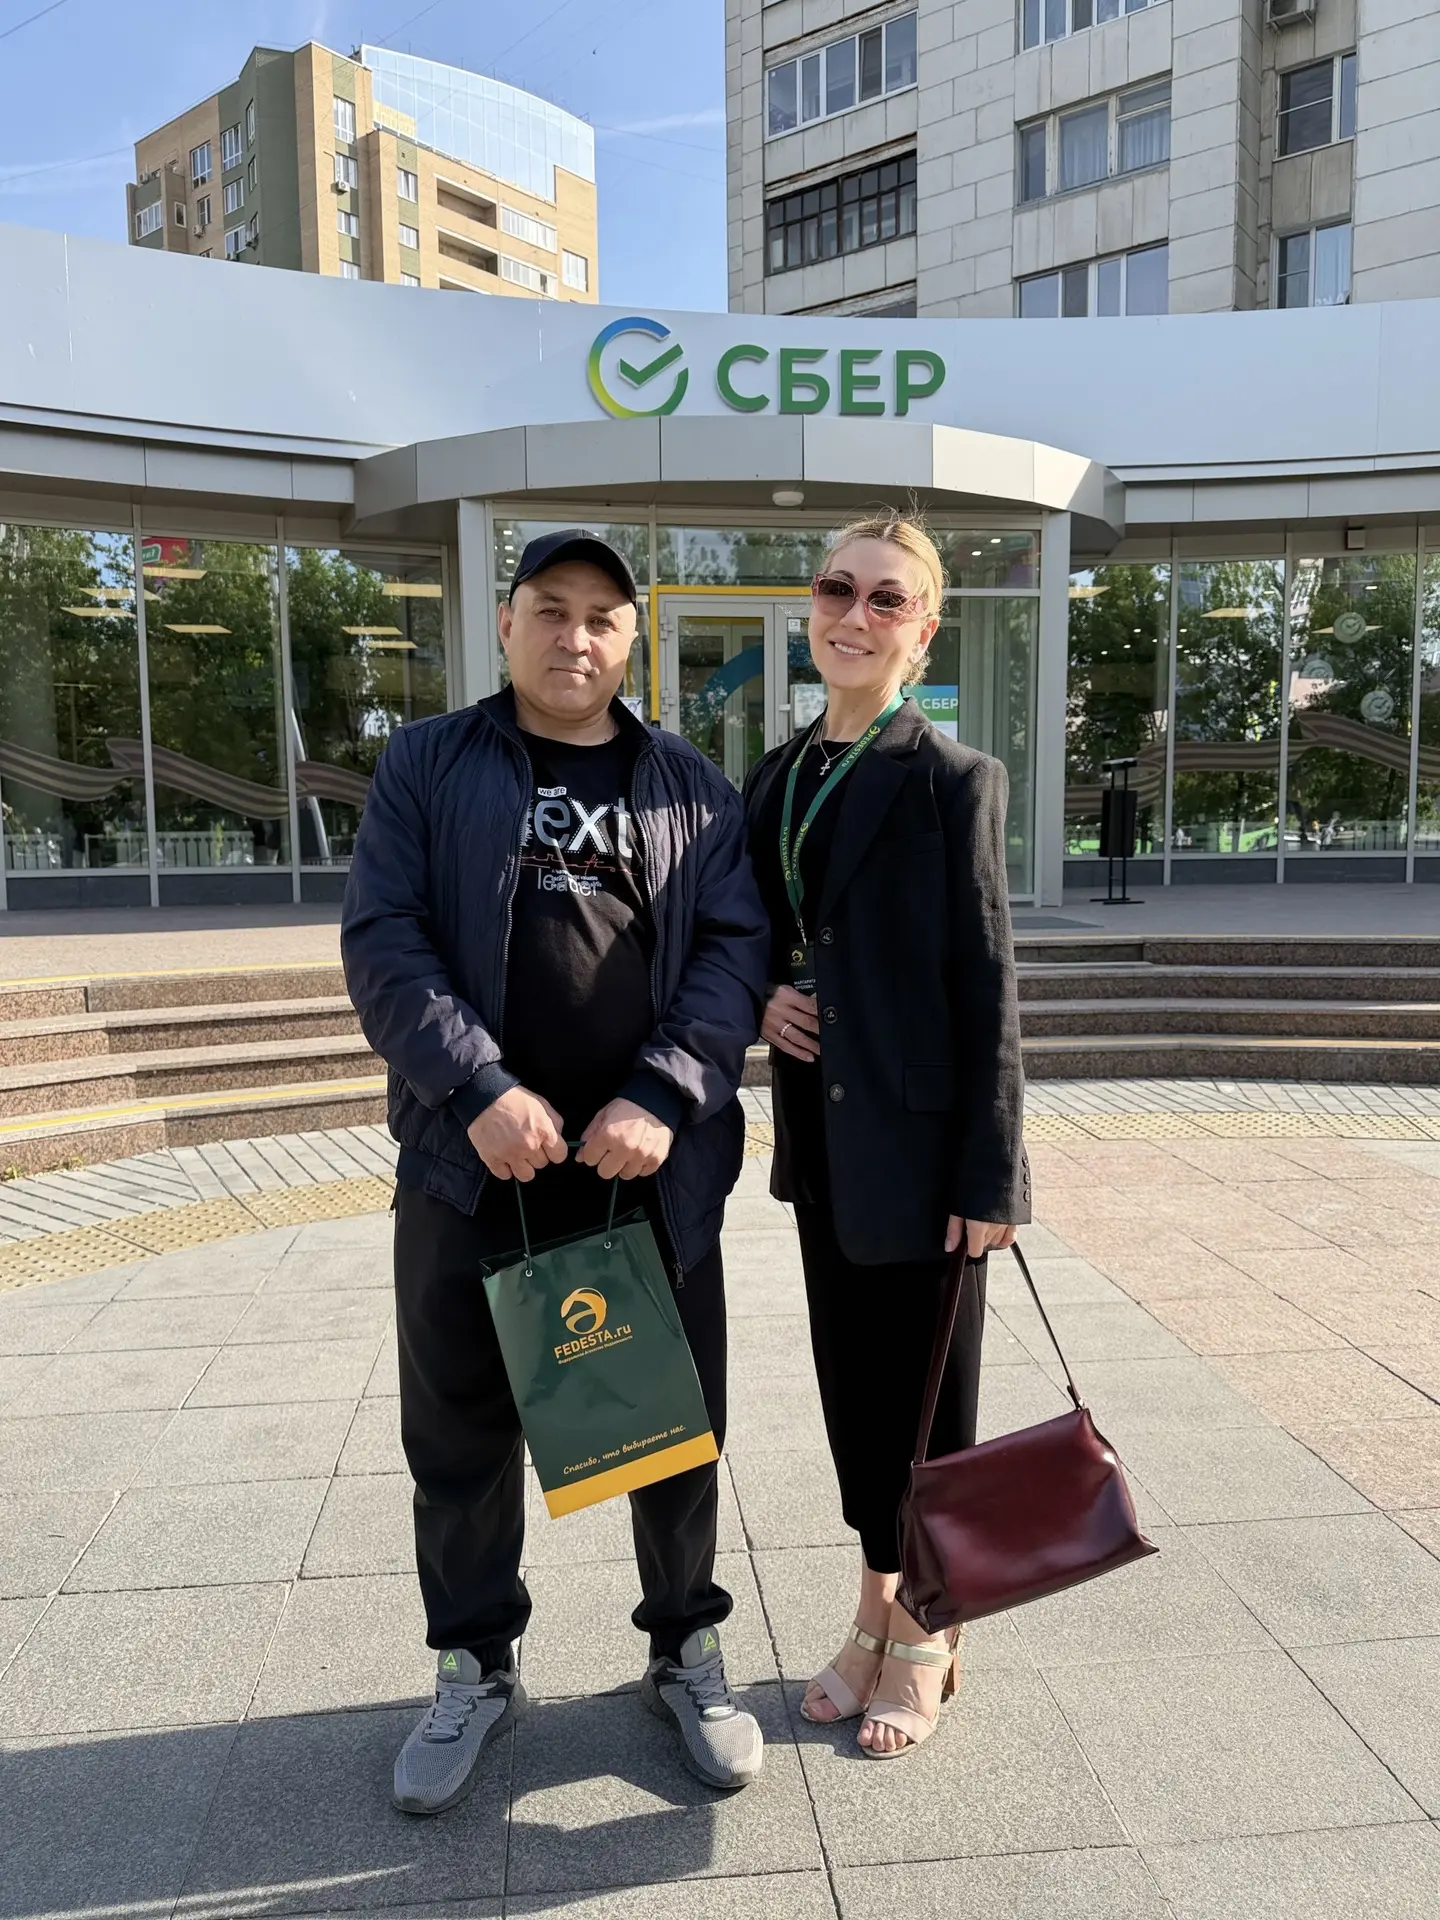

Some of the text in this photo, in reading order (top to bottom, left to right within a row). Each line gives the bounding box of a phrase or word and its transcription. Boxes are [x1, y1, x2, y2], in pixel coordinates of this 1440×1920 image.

[716, 344, 946, 416] СБЕР
[921, 697, 959, 710] СБЕР
[841, 734, 876, 768] FEDESTA.ru
[539, 786, 566, 796] we are
[554, 1324, 632, 1359] FEDESTA.ru
[563, 1423, 687, 1475] Спасибо, что выбираете нас.
